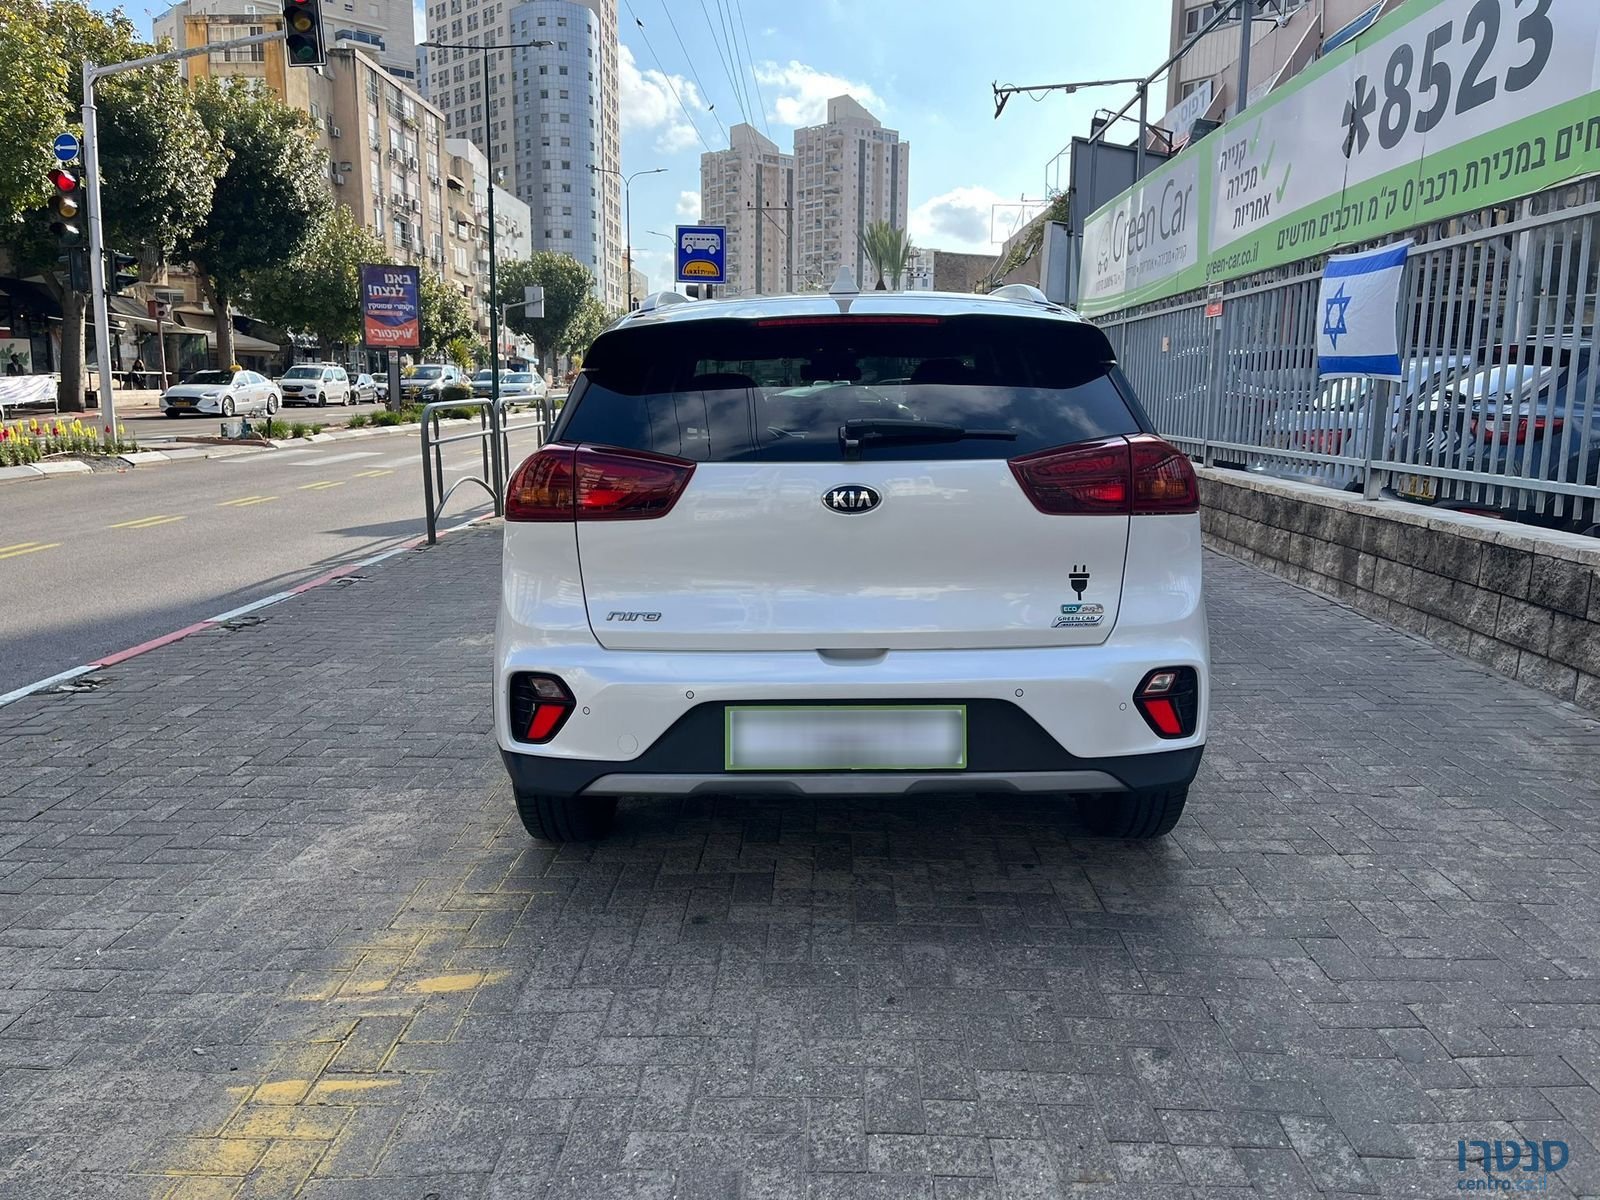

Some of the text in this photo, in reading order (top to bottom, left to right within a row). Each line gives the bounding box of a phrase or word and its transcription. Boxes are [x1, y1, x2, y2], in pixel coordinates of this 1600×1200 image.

[1219, 138, 1247, 173] קנייה
[1462, 136, 1546, 193] במכירת
[1226, 165, 1258, 201] מכירה
[1418, 168, 1458, 205] רכבי
[1113, 179, 1193, 262] Green Car
[1232, 192, 1272, 230] אחריות
[1319, 201, 1364, 237] ורכבים
[1276, 218, 1317, 251] חדשים
[1205, 240, 1260, 281] green-car.co.il
[367, 284, 404, 297] לנצח!
[384, 273, 412, 285] באנו
[832, 490, 872, 508] KIA
